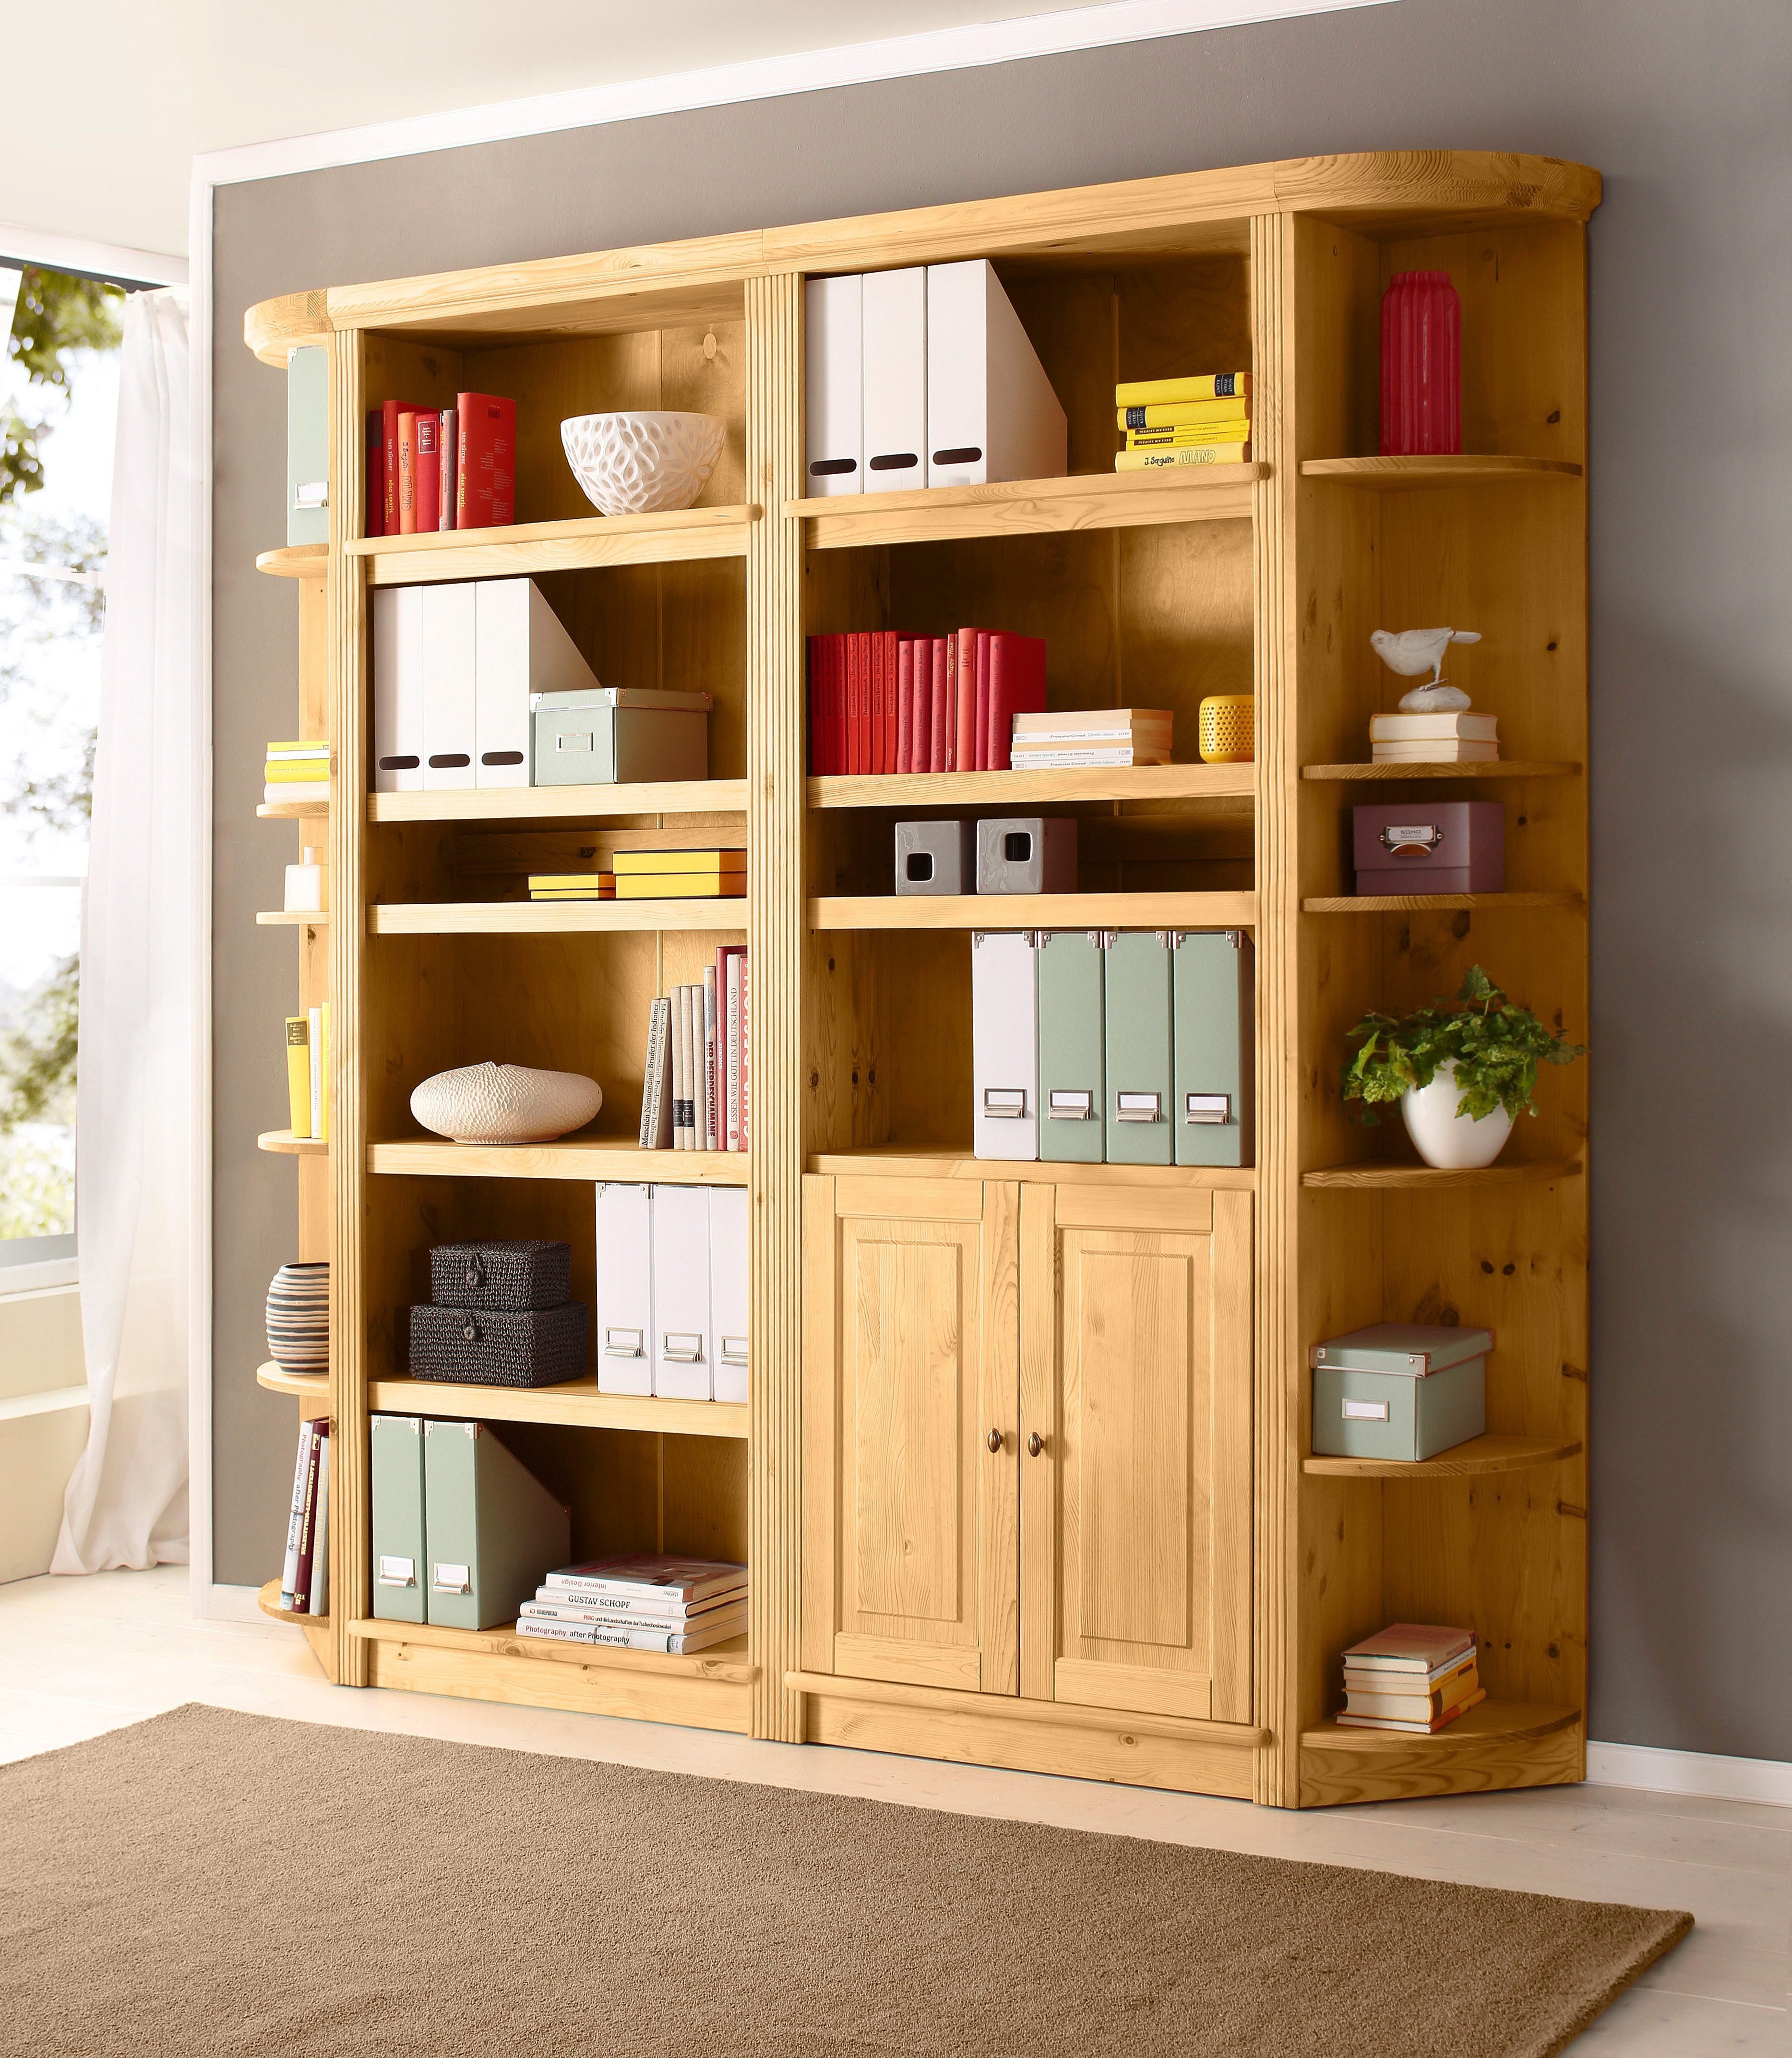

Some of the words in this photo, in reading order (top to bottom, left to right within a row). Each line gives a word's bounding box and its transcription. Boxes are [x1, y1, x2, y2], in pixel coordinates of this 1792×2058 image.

[1179, 450, 1216, 465] MANO
[650, 1004, 658, 1032] Indianer
[647, 1045, 656, 1069] Bruder
[731, 1049, 737, 1058] IN
[641, 1114, 650, 1145] Menchén
[649, 1117, 657, 1145] Indianer
[297, 1434, 308, 1481] Photography
[294, 1484, 302, 1503] after
[288, 1505, 299, 1552] Photography
[561, 1579, 582, 1589] Design
[584, 1581, 607, 1590] Interior
[568, 1595, 598, 1605] GUSTAV
[599, 1598, 631, 1609] SCHOPF
[526, 1625, 567, 1636] Photography
[570, 1630, 586, 1639] after
[588, 1632, 630, 1644] Photography
